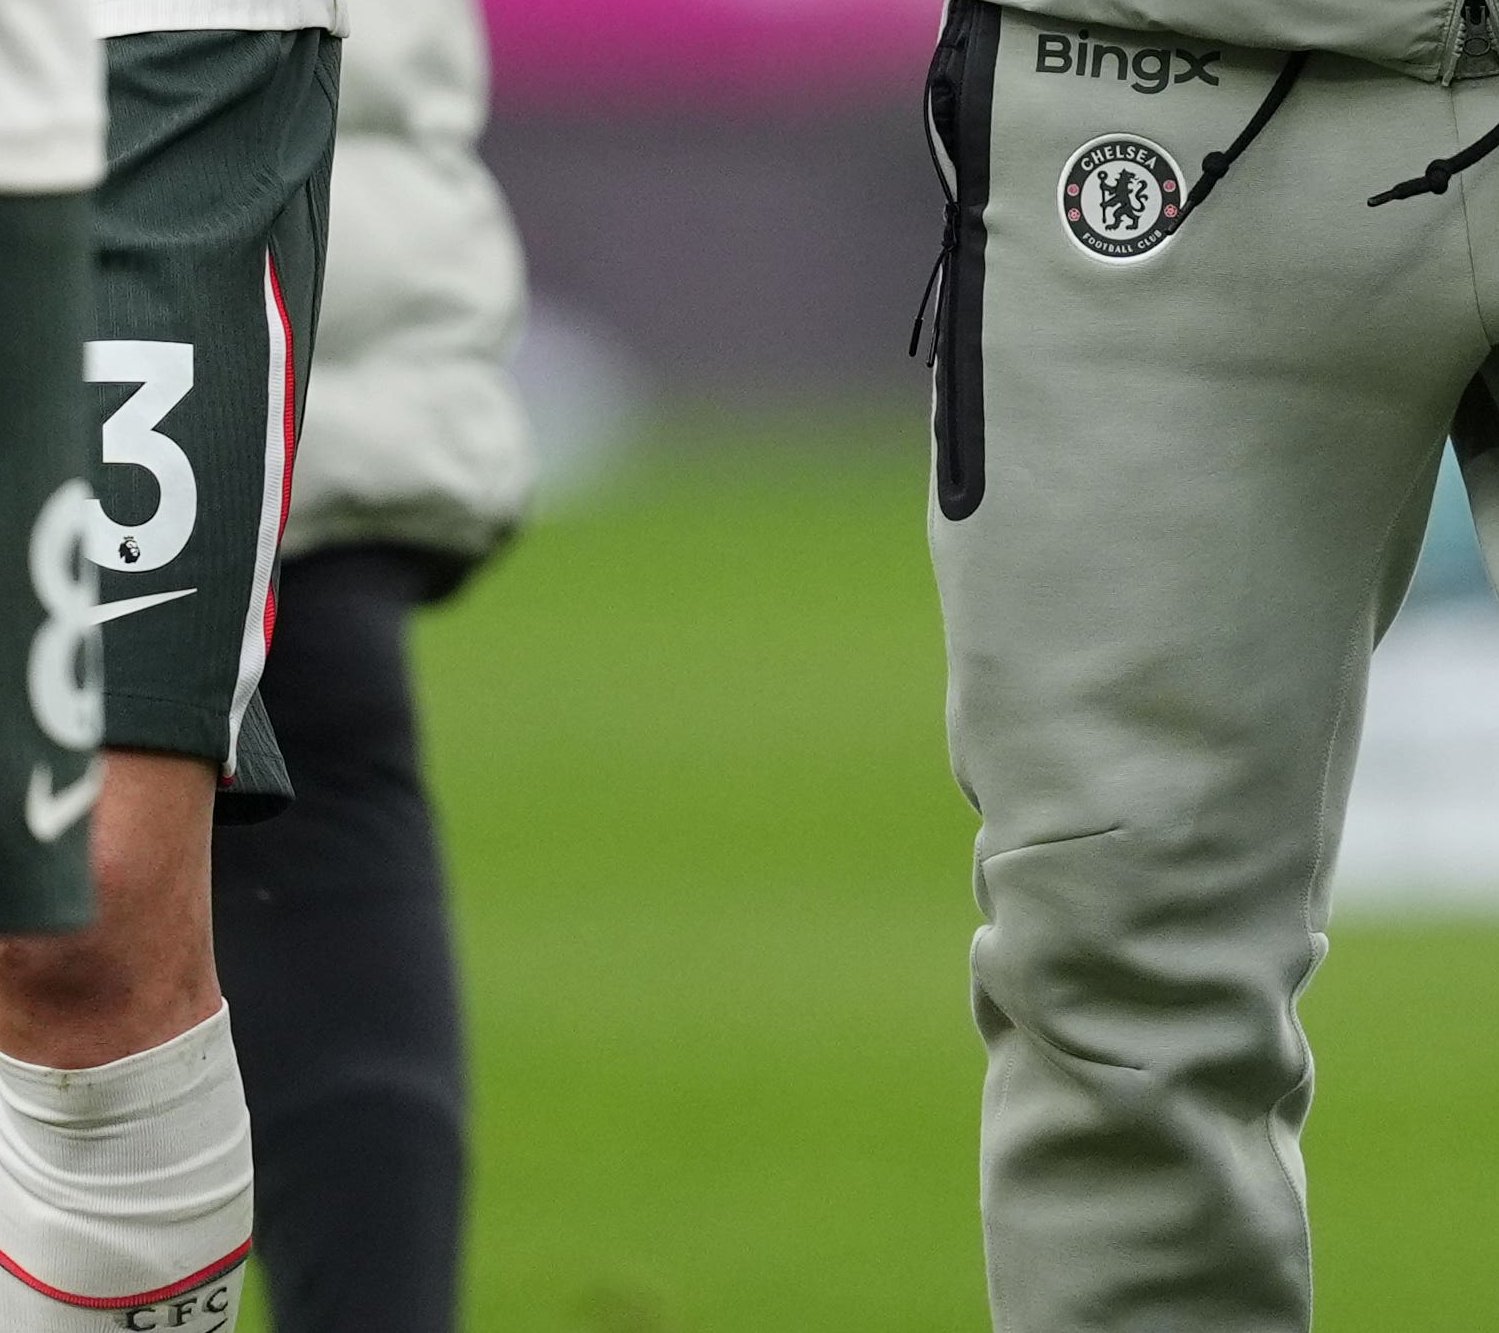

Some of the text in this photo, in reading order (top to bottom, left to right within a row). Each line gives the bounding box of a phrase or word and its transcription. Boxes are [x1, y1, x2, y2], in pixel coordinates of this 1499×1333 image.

[1080, 145, 1157, 172] CHELSEA
[1082, 229, 1162, 254] FOOTBALL CLUB
[82, 339, 198, 573] 3
[116, 1286, 229, 1332] CFC
